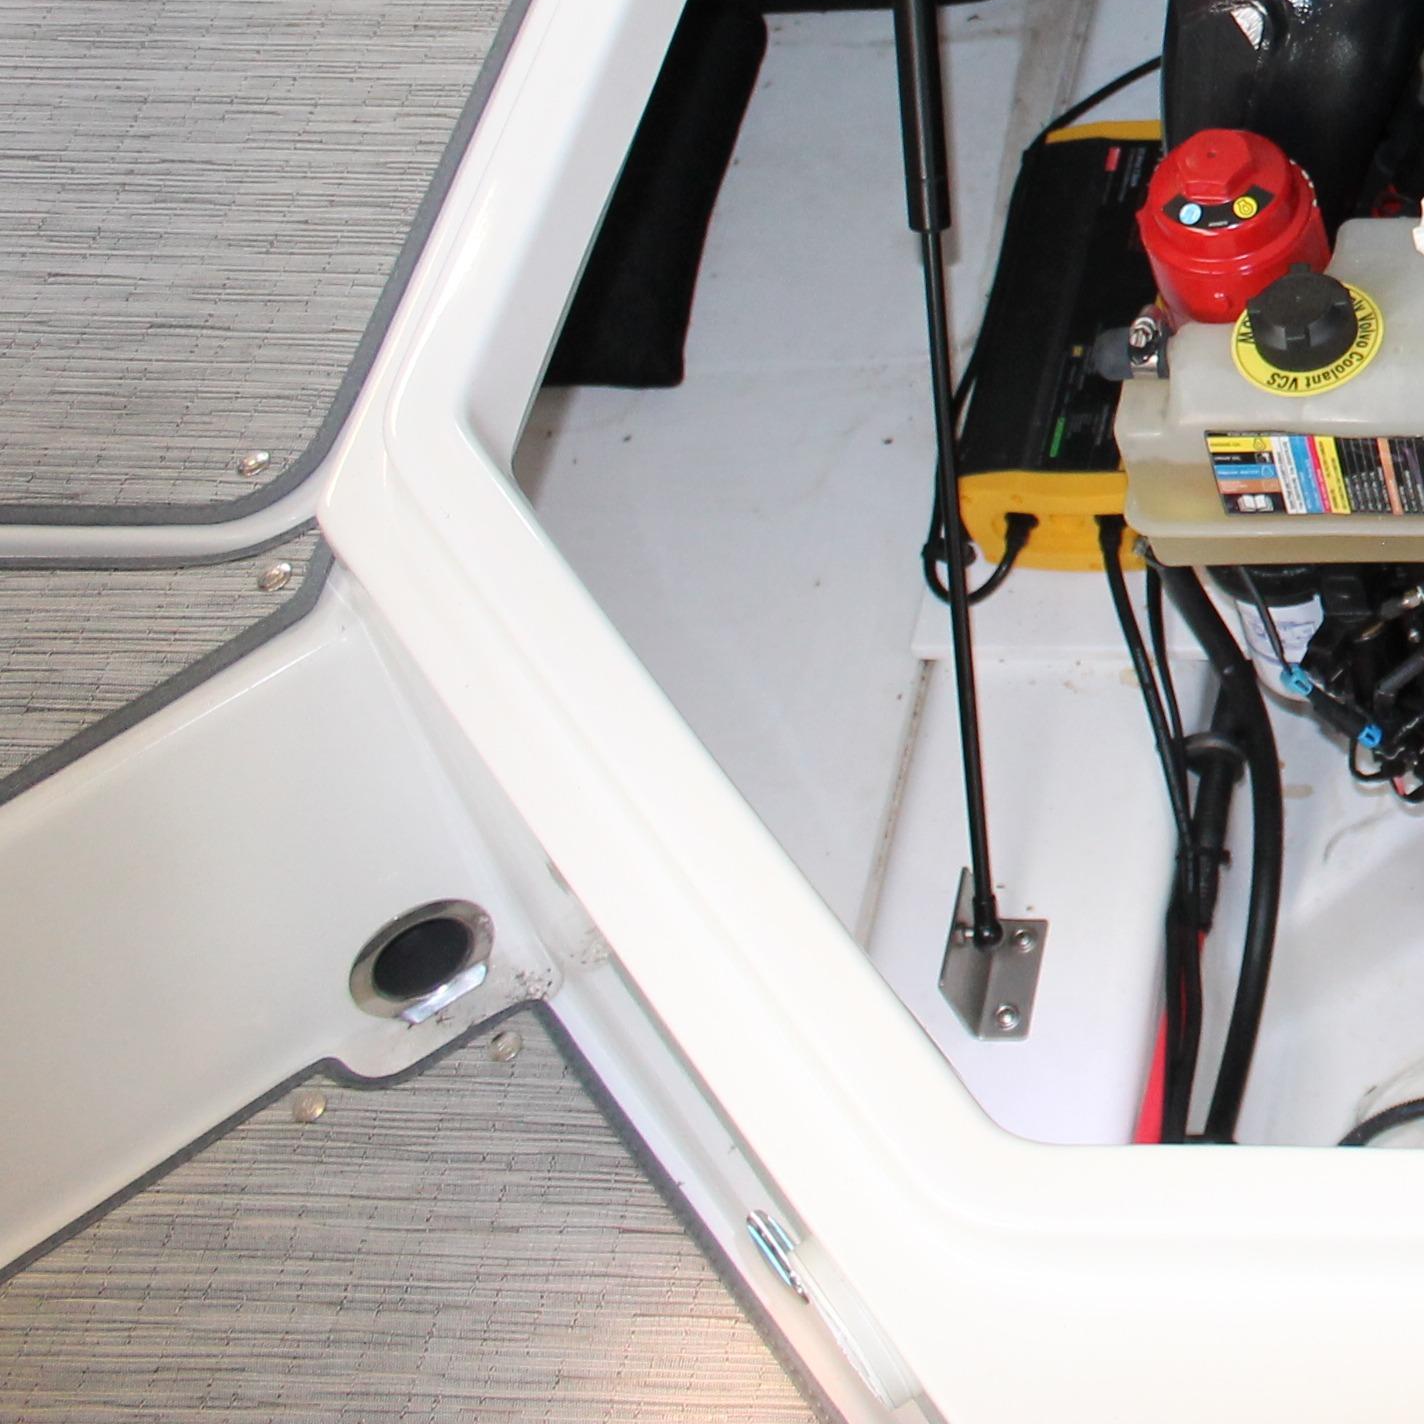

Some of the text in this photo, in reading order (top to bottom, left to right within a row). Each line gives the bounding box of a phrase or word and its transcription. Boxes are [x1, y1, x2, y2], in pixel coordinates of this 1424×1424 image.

[1358, 313, 1376, 349] Volvo
[1266, 372, 1298, 391] VCS
[1306, 351, 1364, 389] Coolant
